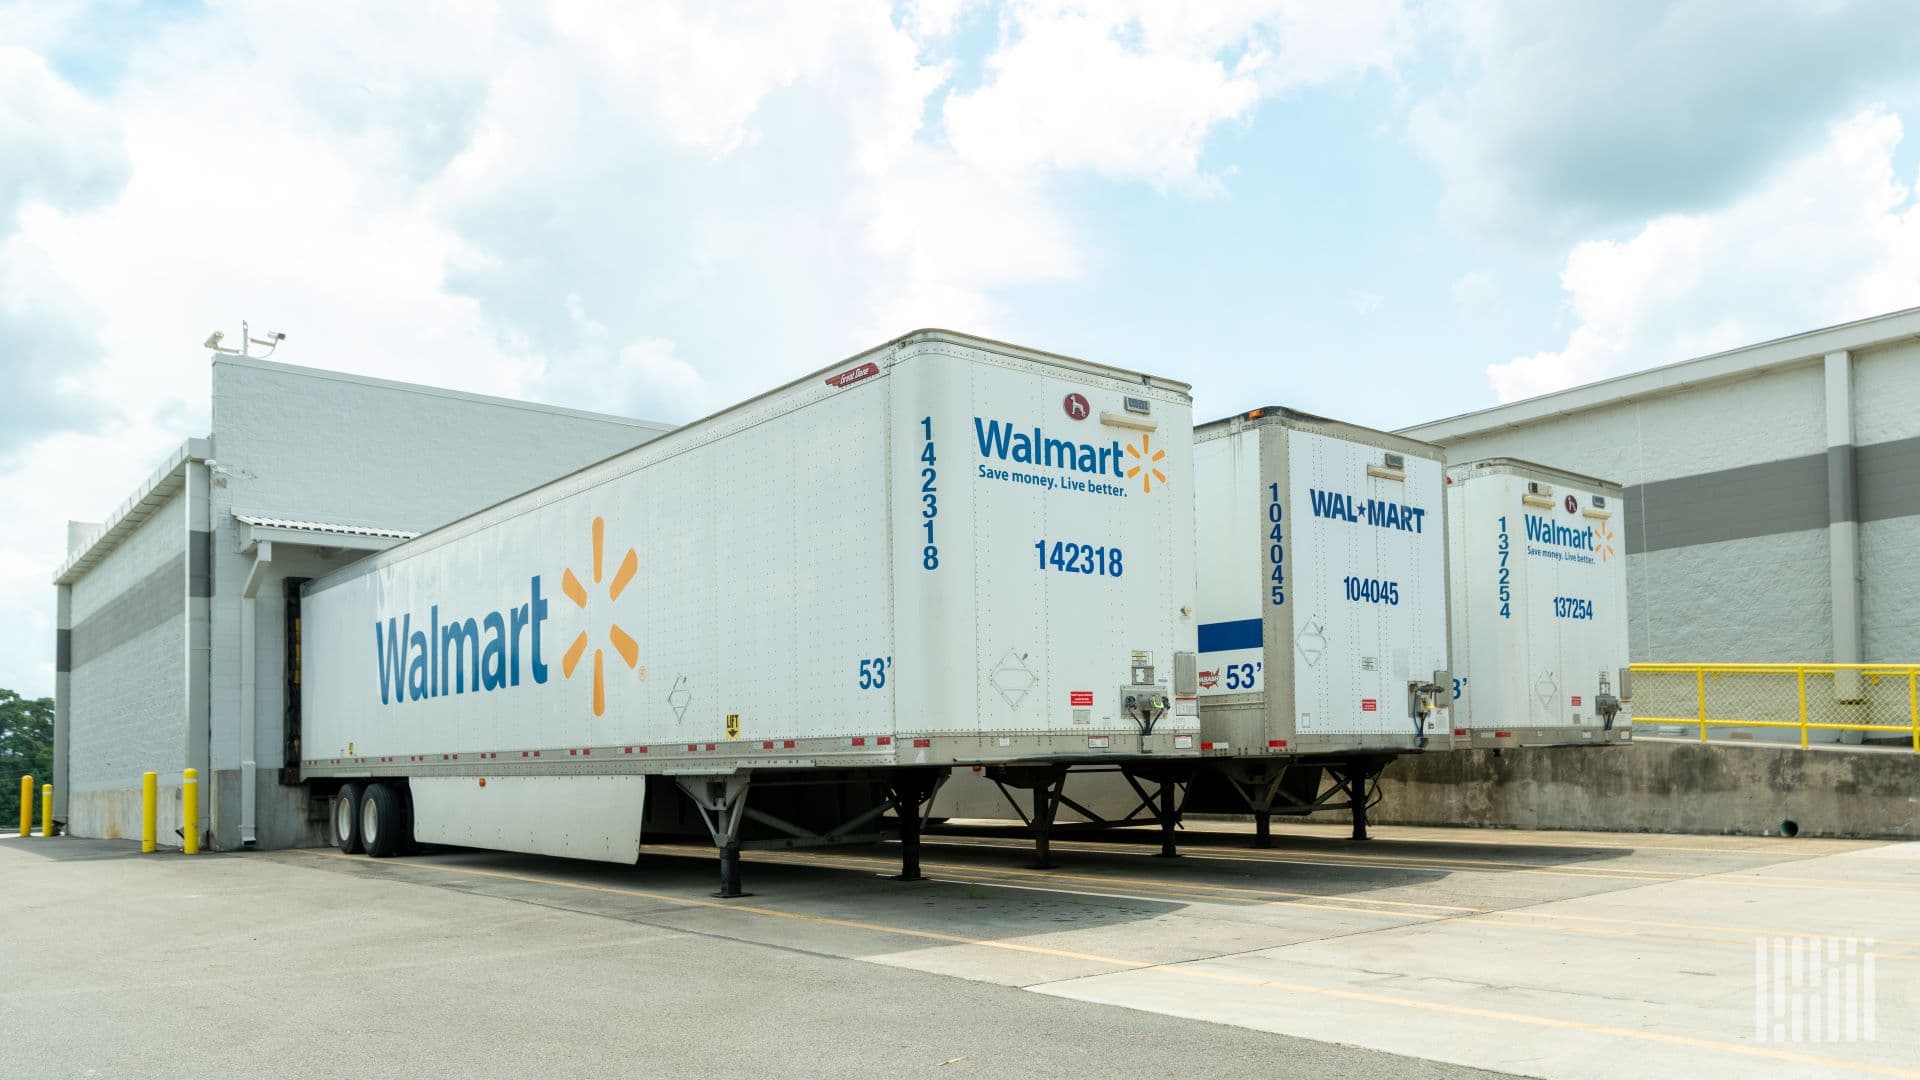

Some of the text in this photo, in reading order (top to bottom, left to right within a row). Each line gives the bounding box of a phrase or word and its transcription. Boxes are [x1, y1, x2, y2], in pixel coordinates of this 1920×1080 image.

[974, 417, 1123, 478] Walmart
[921, 416, 939, 570] 142318
[978, 464, 1128, 497] Save money. Live better.
[1525, 514, 1593, 551] Walmart
[1035, 539, 1123, 577] 142318
[1527, 545, 1596, 565] Save money. Live better.
[1344, 576, 1399, 606] 104045
[1553, 596, 1593, 620] 137254
[375, 575, 548, 705] Walmart
[859, 656, 892, 690] 53'
[1226, 662, 1262, 690] 53'
[726, 714, 739, 728] LIFT
